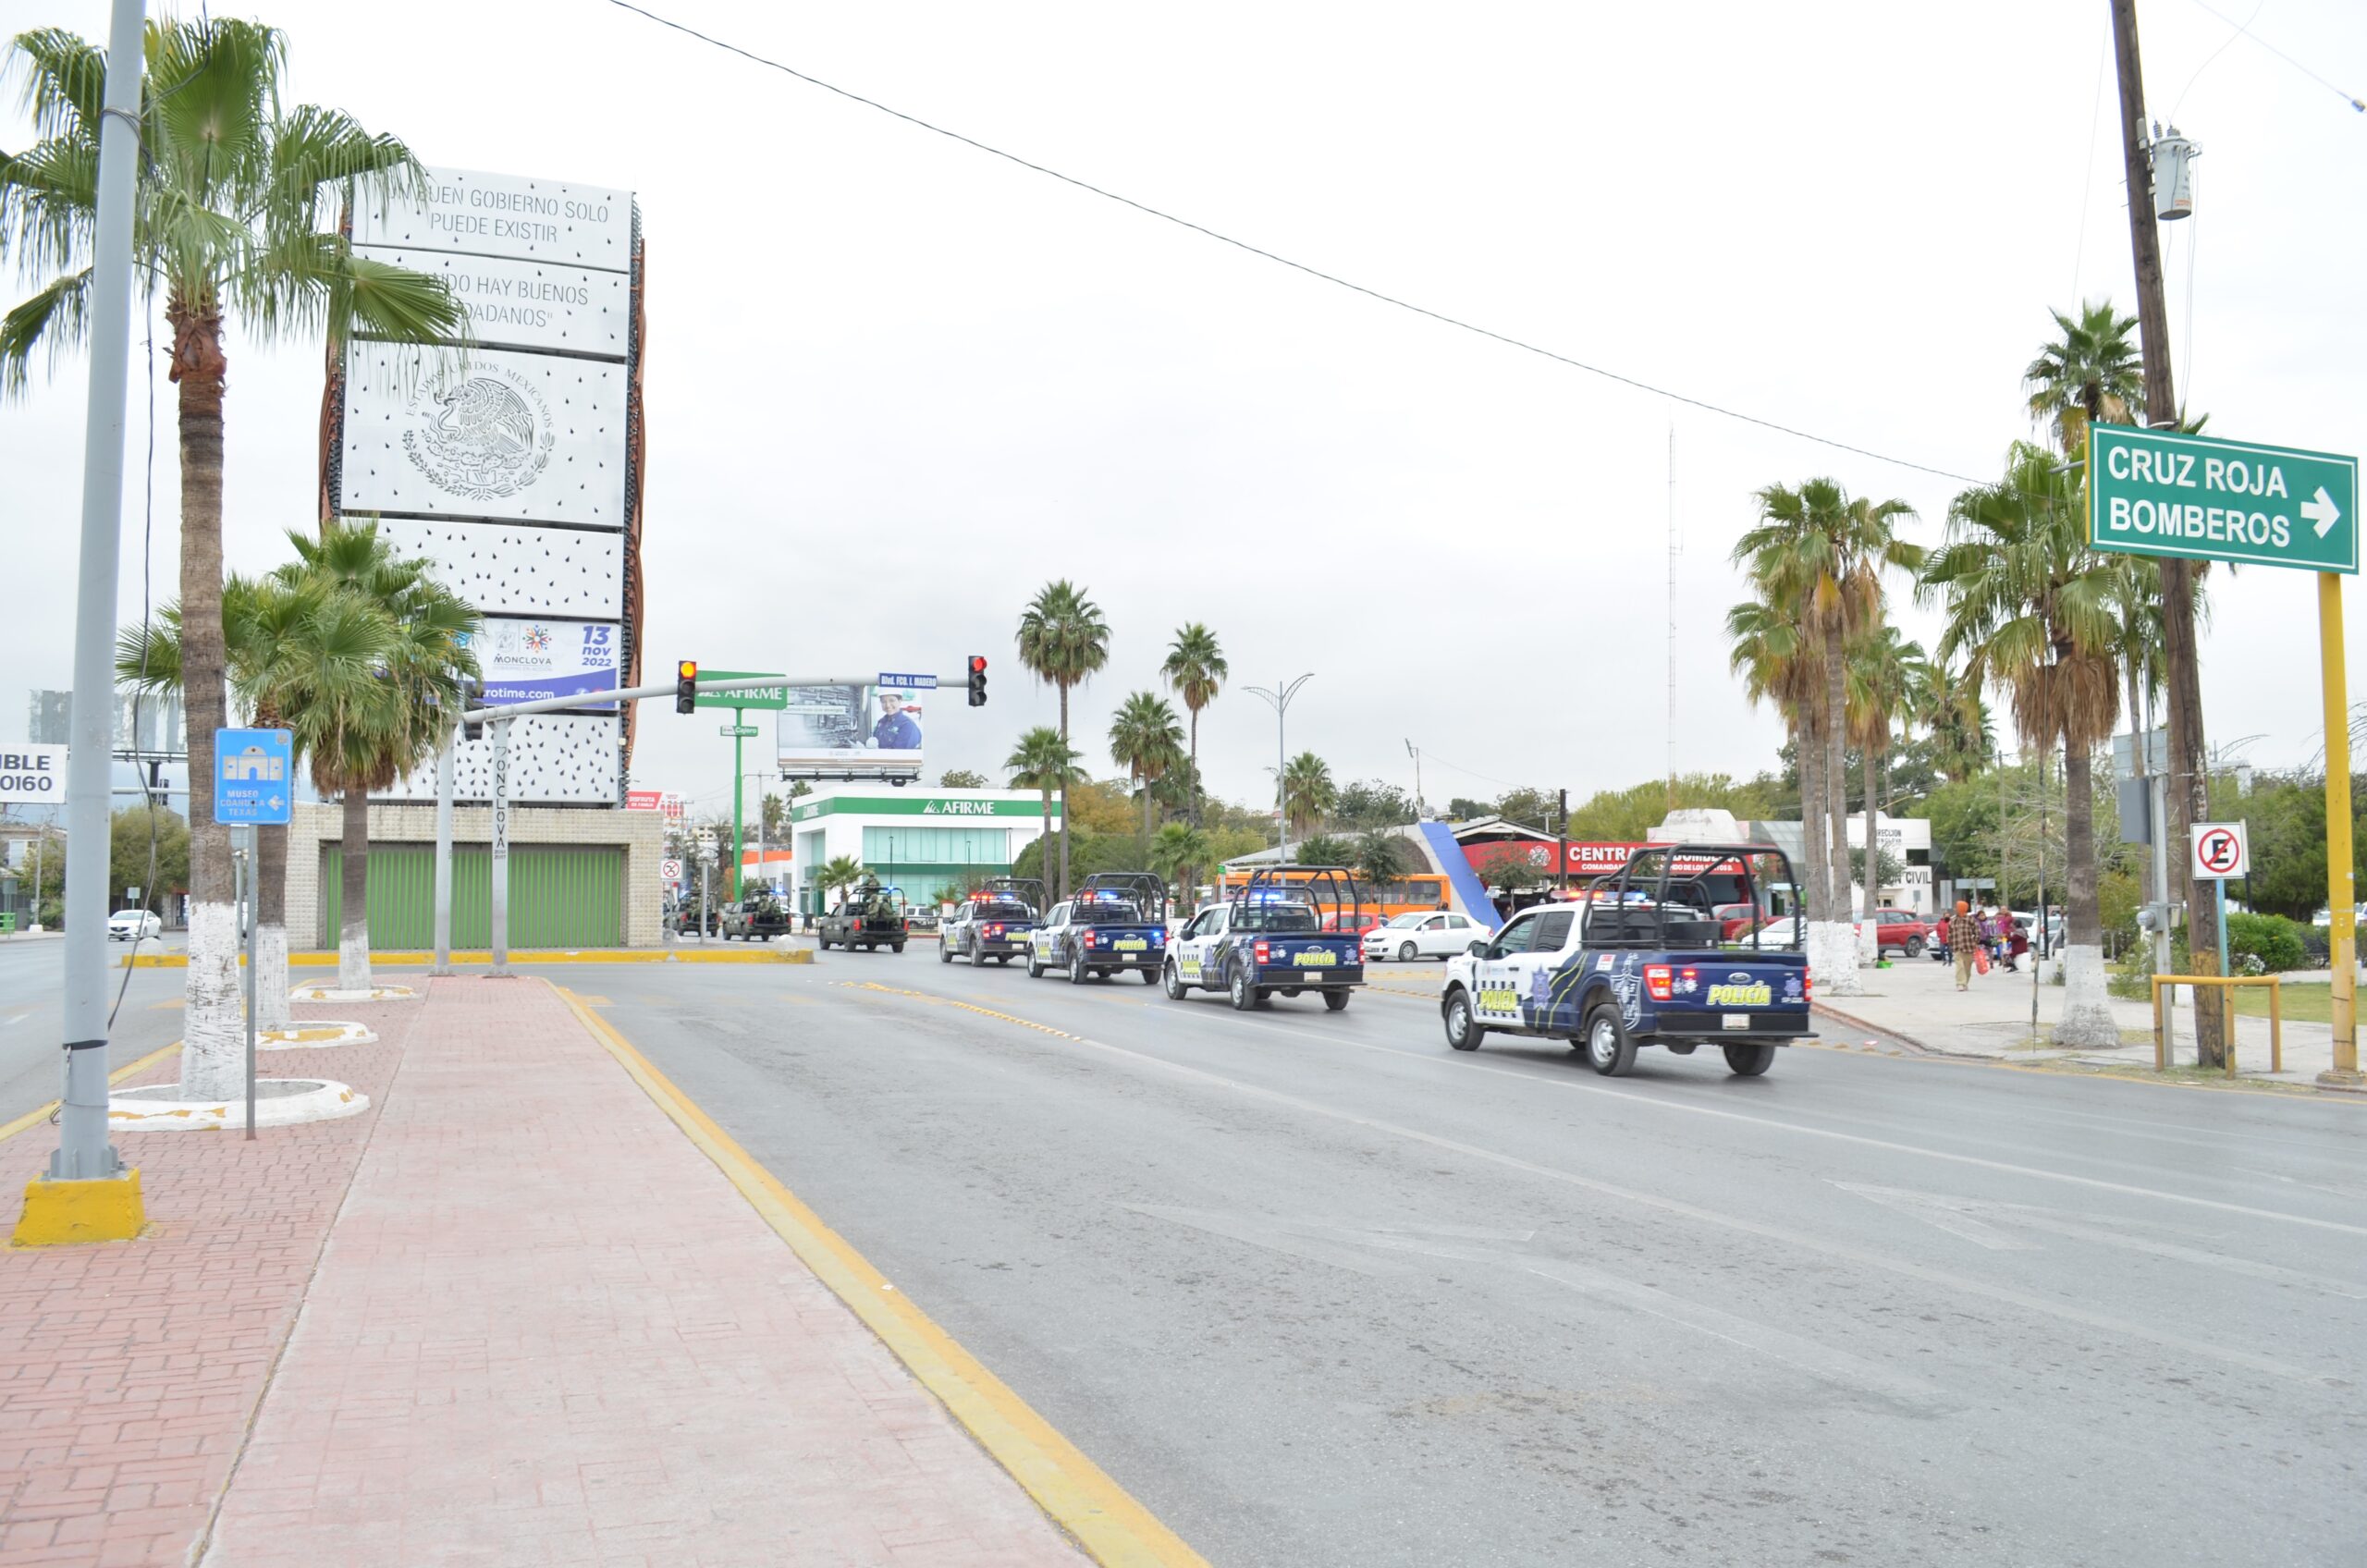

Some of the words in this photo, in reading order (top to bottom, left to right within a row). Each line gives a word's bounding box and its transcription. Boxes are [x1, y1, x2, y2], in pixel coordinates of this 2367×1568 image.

[471, 188, 558, 216] GOBIERNO
[565, 201, 608, 223] SOLO
[430, 213, 489, 235] PUEDE
[495, 218, 557, 243] EXISTIR
[477, 276, 512, 297] HAY
[518, 280, 588, 306] BUENOS
[463, 302, 553, 327] DADANOS"
[504, 368, 554, 429] MEXICANOS
[2108, 446, 2197, 488] CRUZ
[2205, 458, 2288, 499] ROJA
[2110, 496, 2290, 548] BOMBEROS
[583, 625, 611, 645] 13
[582, 646, 611, 656] nov
[494, 654, 553, 666] MONCLOVA
[582, 656, 612, 667] 2022
[483, 687, 555, 700] rotime.com
[227, 790, 259, 798] MUSEO
[227, 808, 258, 816] TEXAS
[941, 802, 995, 815] AFIRME
[1569, 846, 1636, 862] CENTRA
[1906, 871, 1932, 884] CIVIL
[1294, 949, 1337, 965] POLICÍA
[1706, 980, 1772, 1006] POLICÍA
